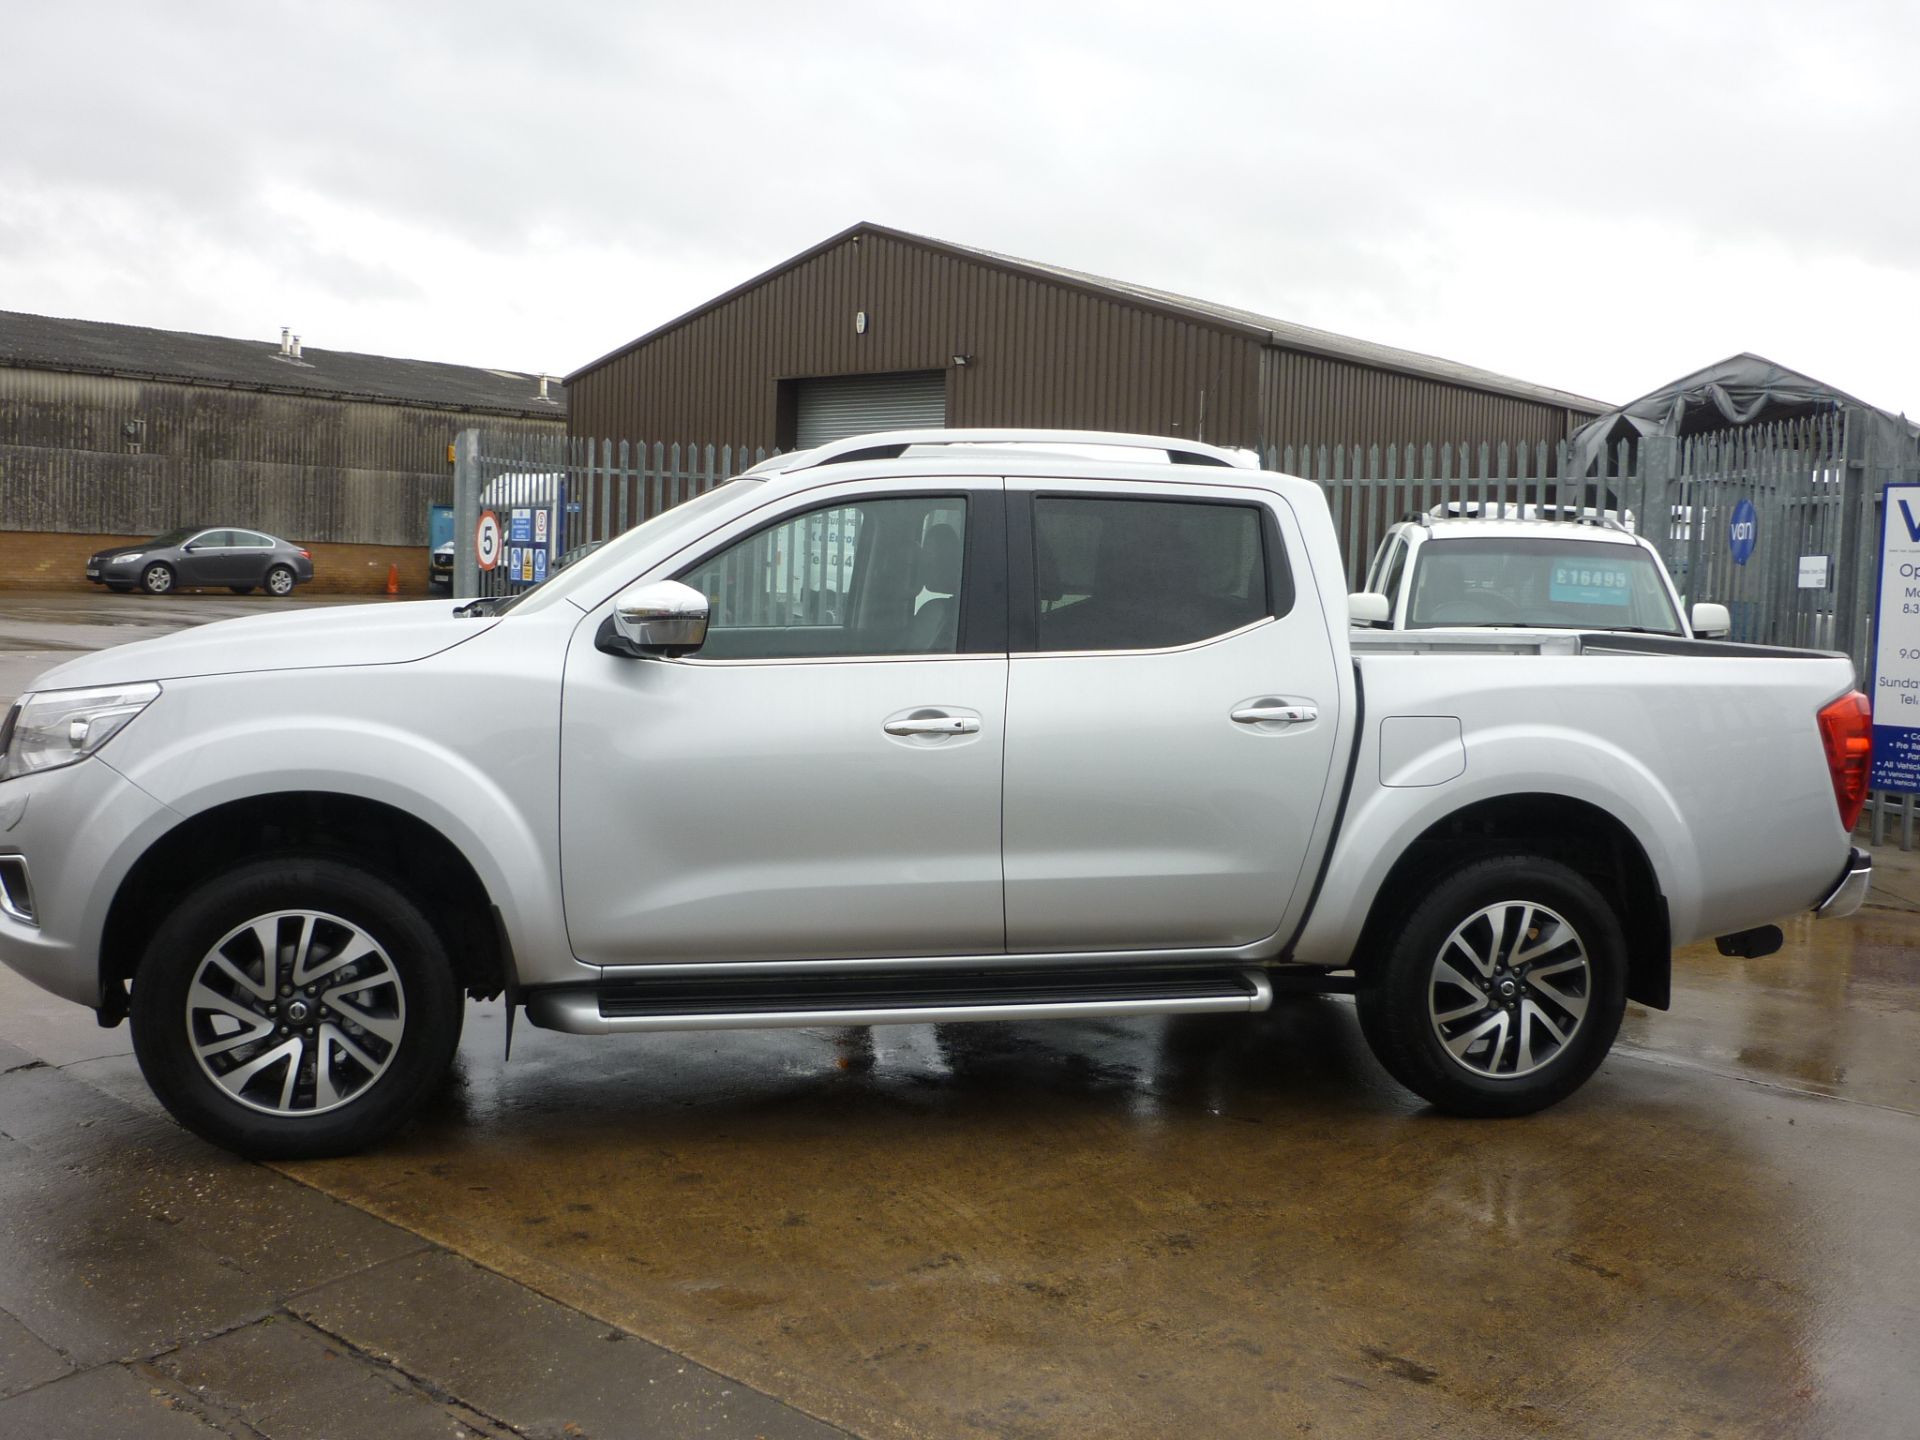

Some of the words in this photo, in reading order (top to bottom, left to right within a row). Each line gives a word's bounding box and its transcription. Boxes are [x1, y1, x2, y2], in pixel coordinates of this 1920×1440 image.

[1731, 522, 1752, 540] van
[483, 526, 492, 555] 5
[1556, 569, 1627, 588] £16495
[1883, 760, 1894, 769] All
[1893, 779, 1918, 788] Vehicle
